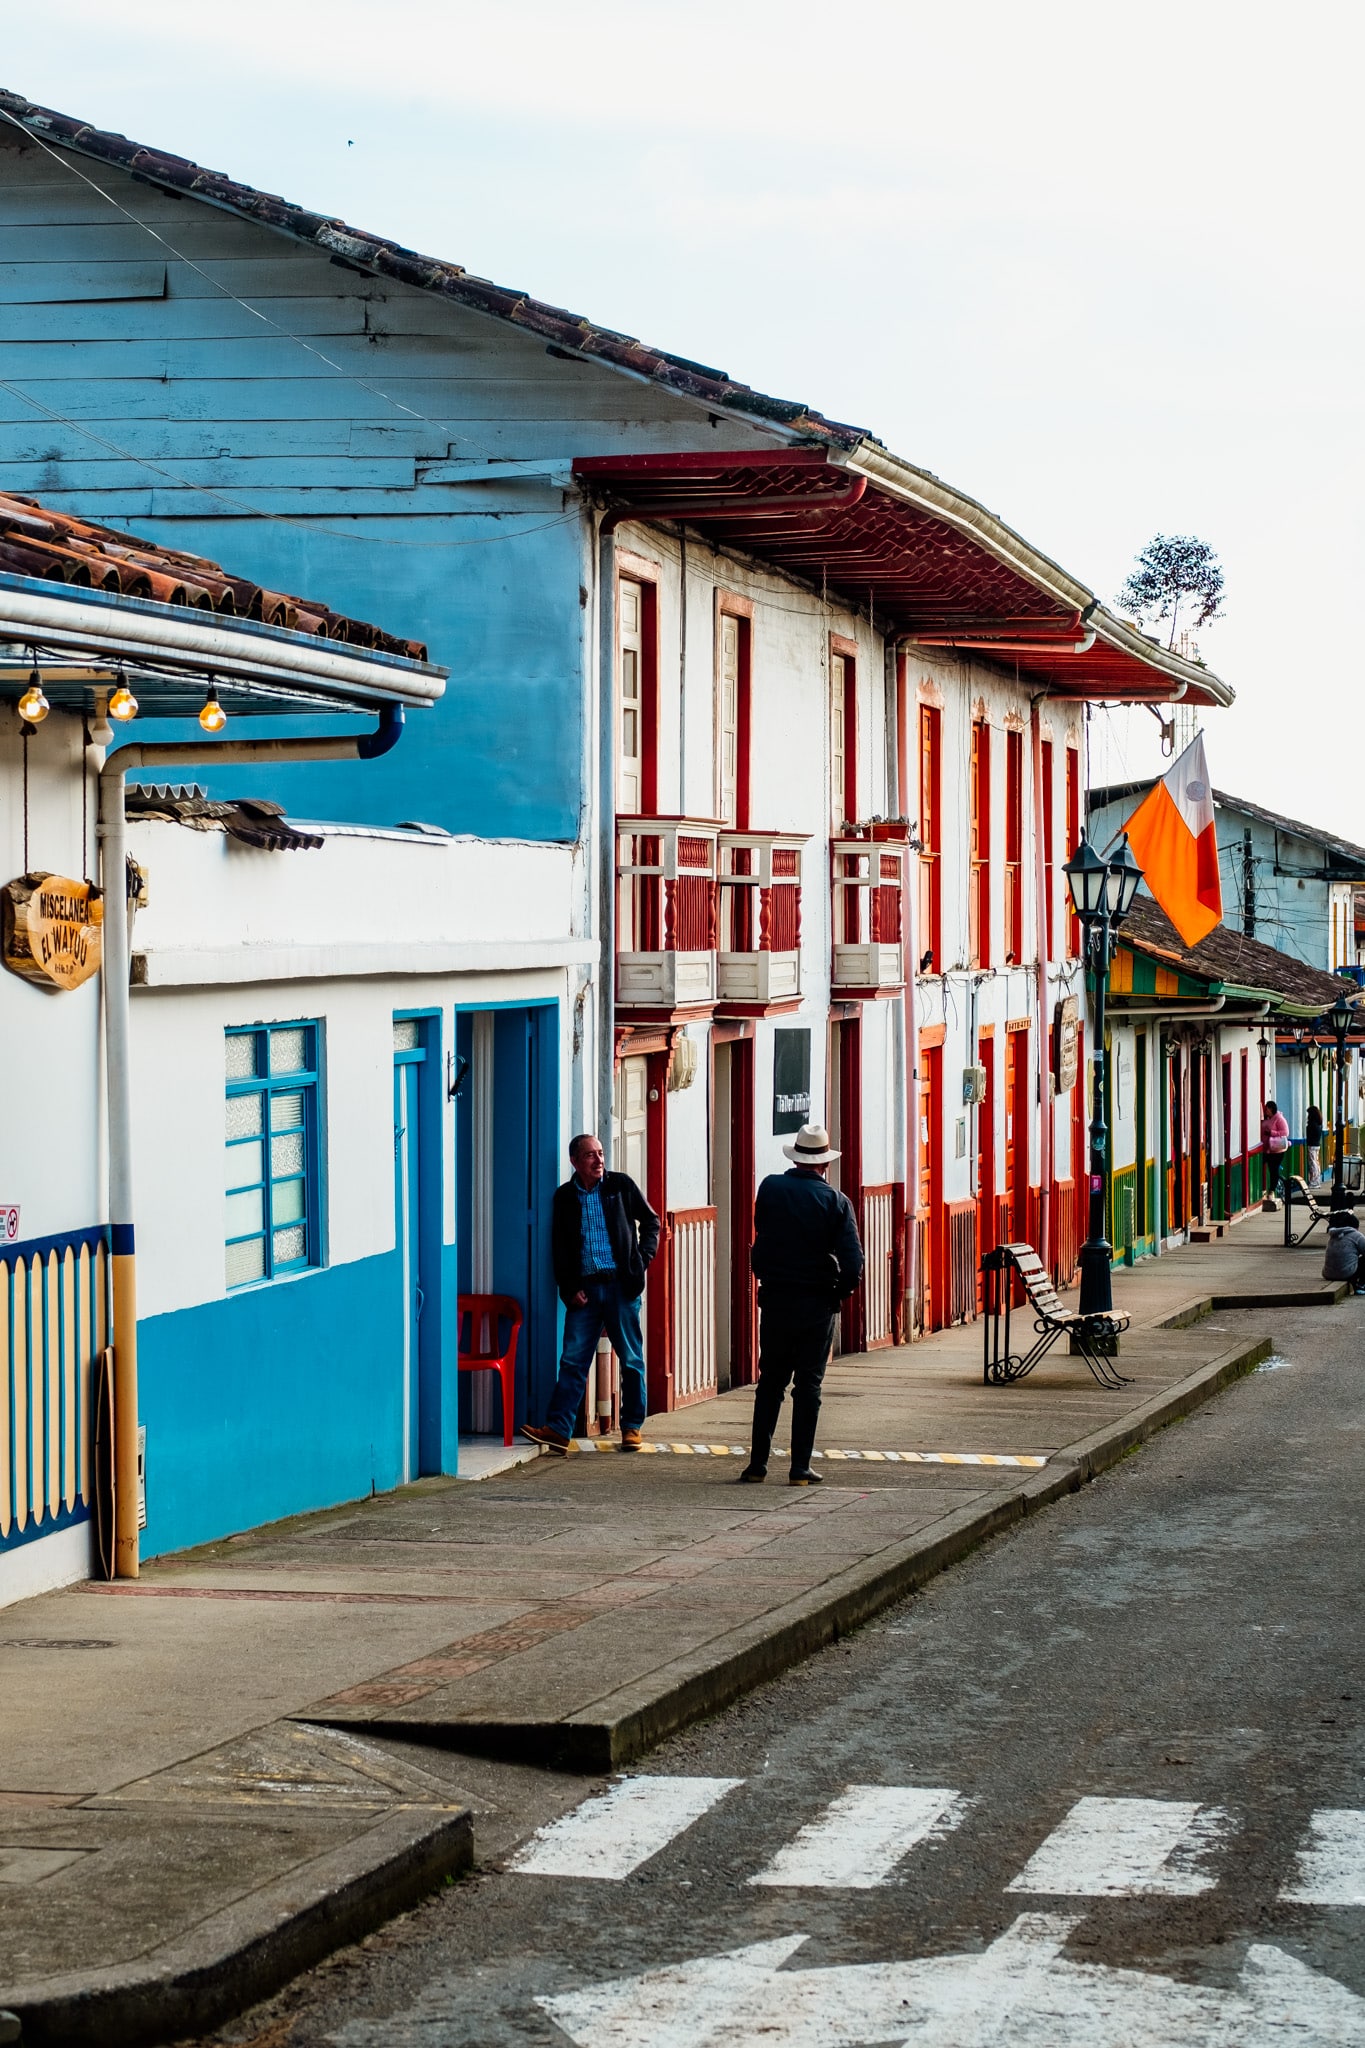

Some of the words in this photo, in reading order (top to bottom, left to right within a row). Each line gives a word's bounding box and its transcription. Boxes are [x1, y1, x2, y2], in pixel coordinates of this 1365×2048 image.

[40, 893, 89, 924] MISCELANEA
[42, 933, 52, 965] EL
[53, 925, 87, 966] WAYUU
